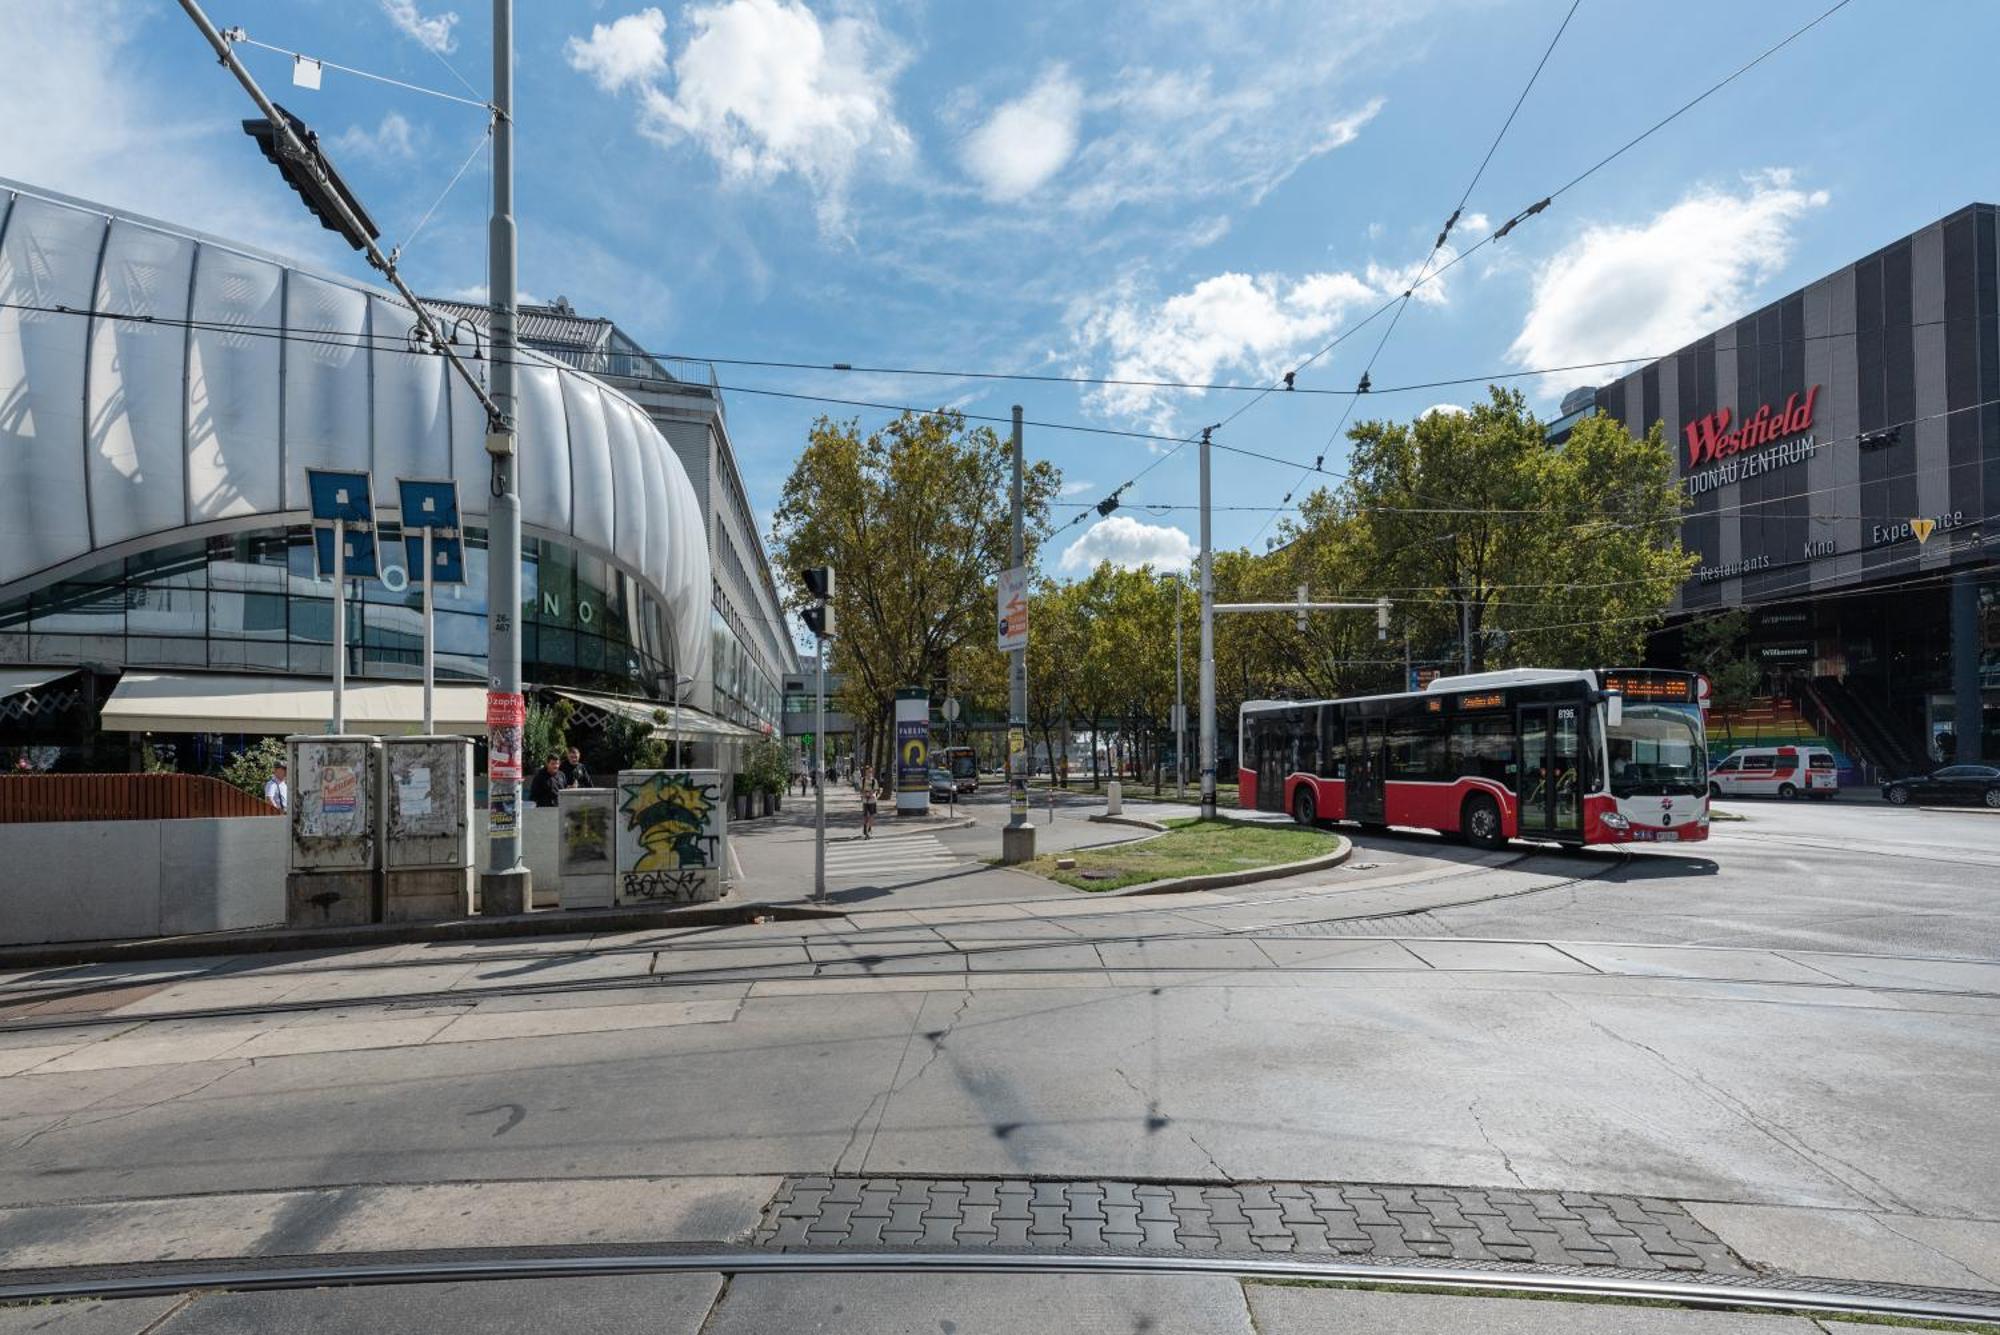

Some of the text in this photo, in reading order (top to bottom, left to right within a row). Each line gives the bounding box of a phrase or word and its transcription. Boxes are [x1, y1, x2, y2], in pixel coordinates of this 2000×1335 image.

[1685, 383, 1819, 469] Westfield
[1689, 434, 1815, 496] DONAU ZENTRUM
[1873, 511, 1963, 544] Expence
[1804, 540, 1835, 560] Kino
[1700, 555, 1770, 582] Restaurants
